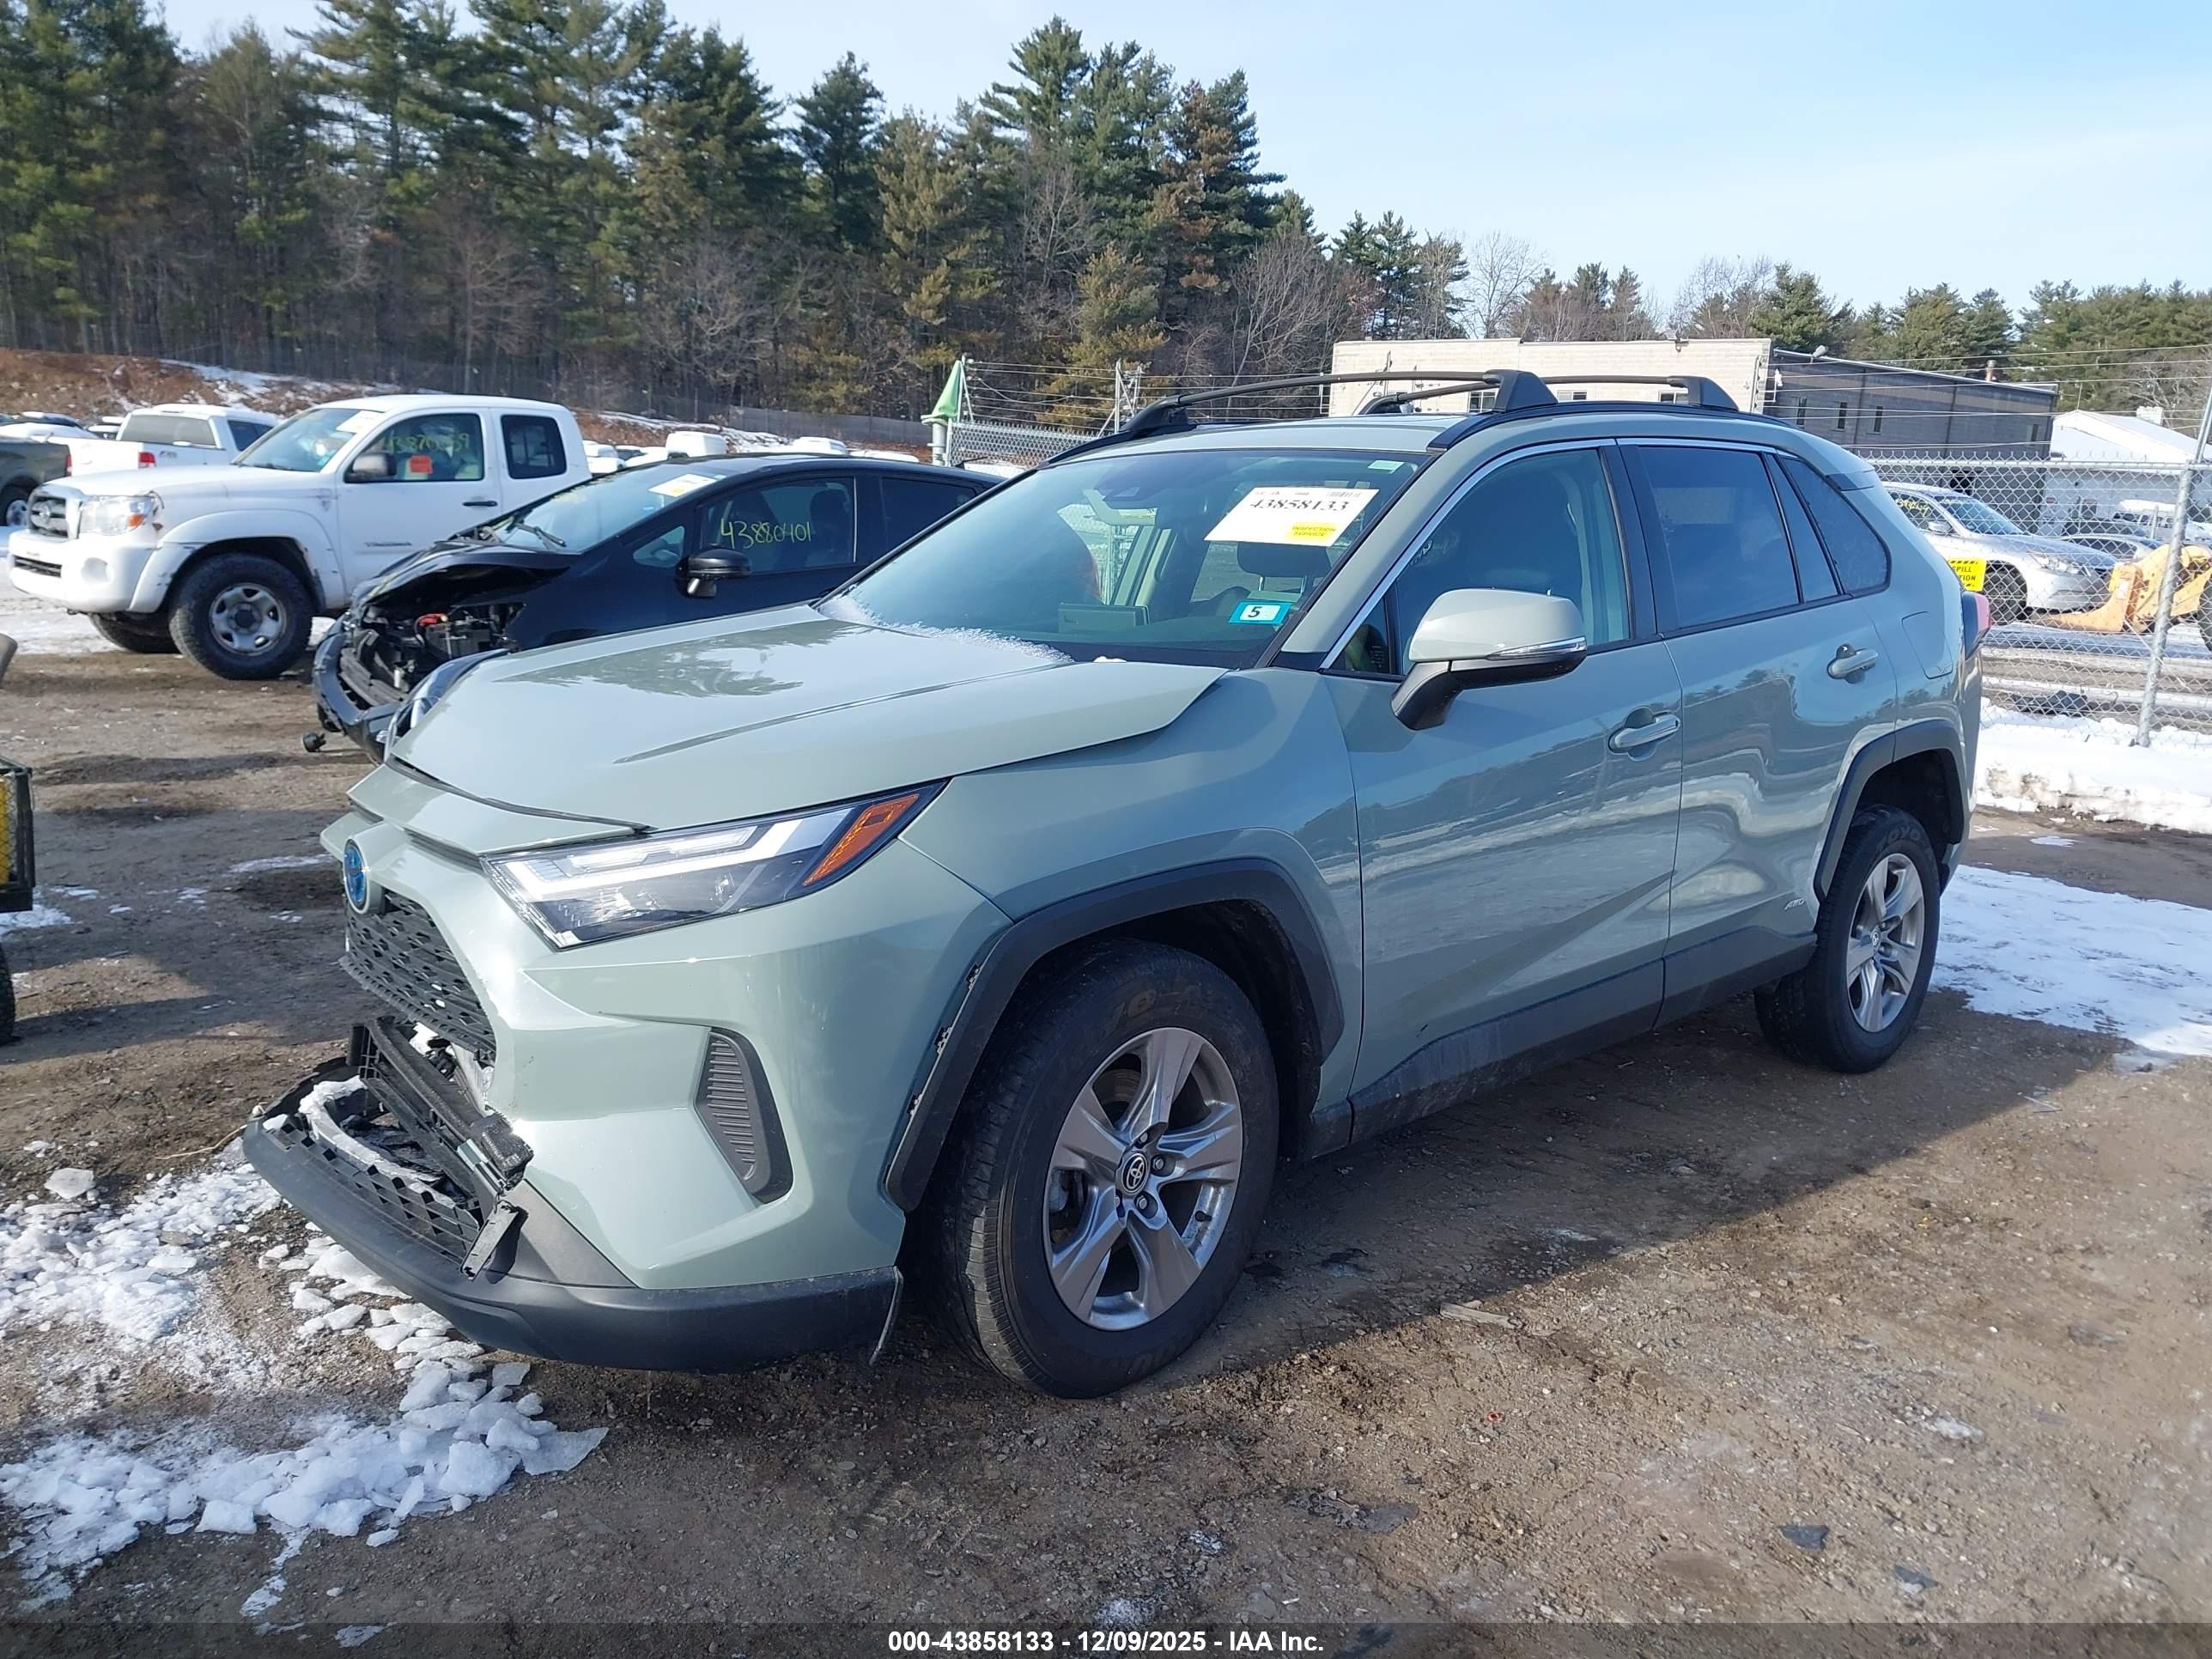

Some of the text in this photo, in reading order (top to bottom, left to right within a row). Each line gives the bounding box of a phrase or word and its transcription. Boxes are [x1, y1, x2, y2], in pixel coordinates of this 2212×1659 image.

[1250, 499, 1350, 511] 43858133
[721, 518, 811, 550] 43880401
[1248, 606, 1262, 618] 5
